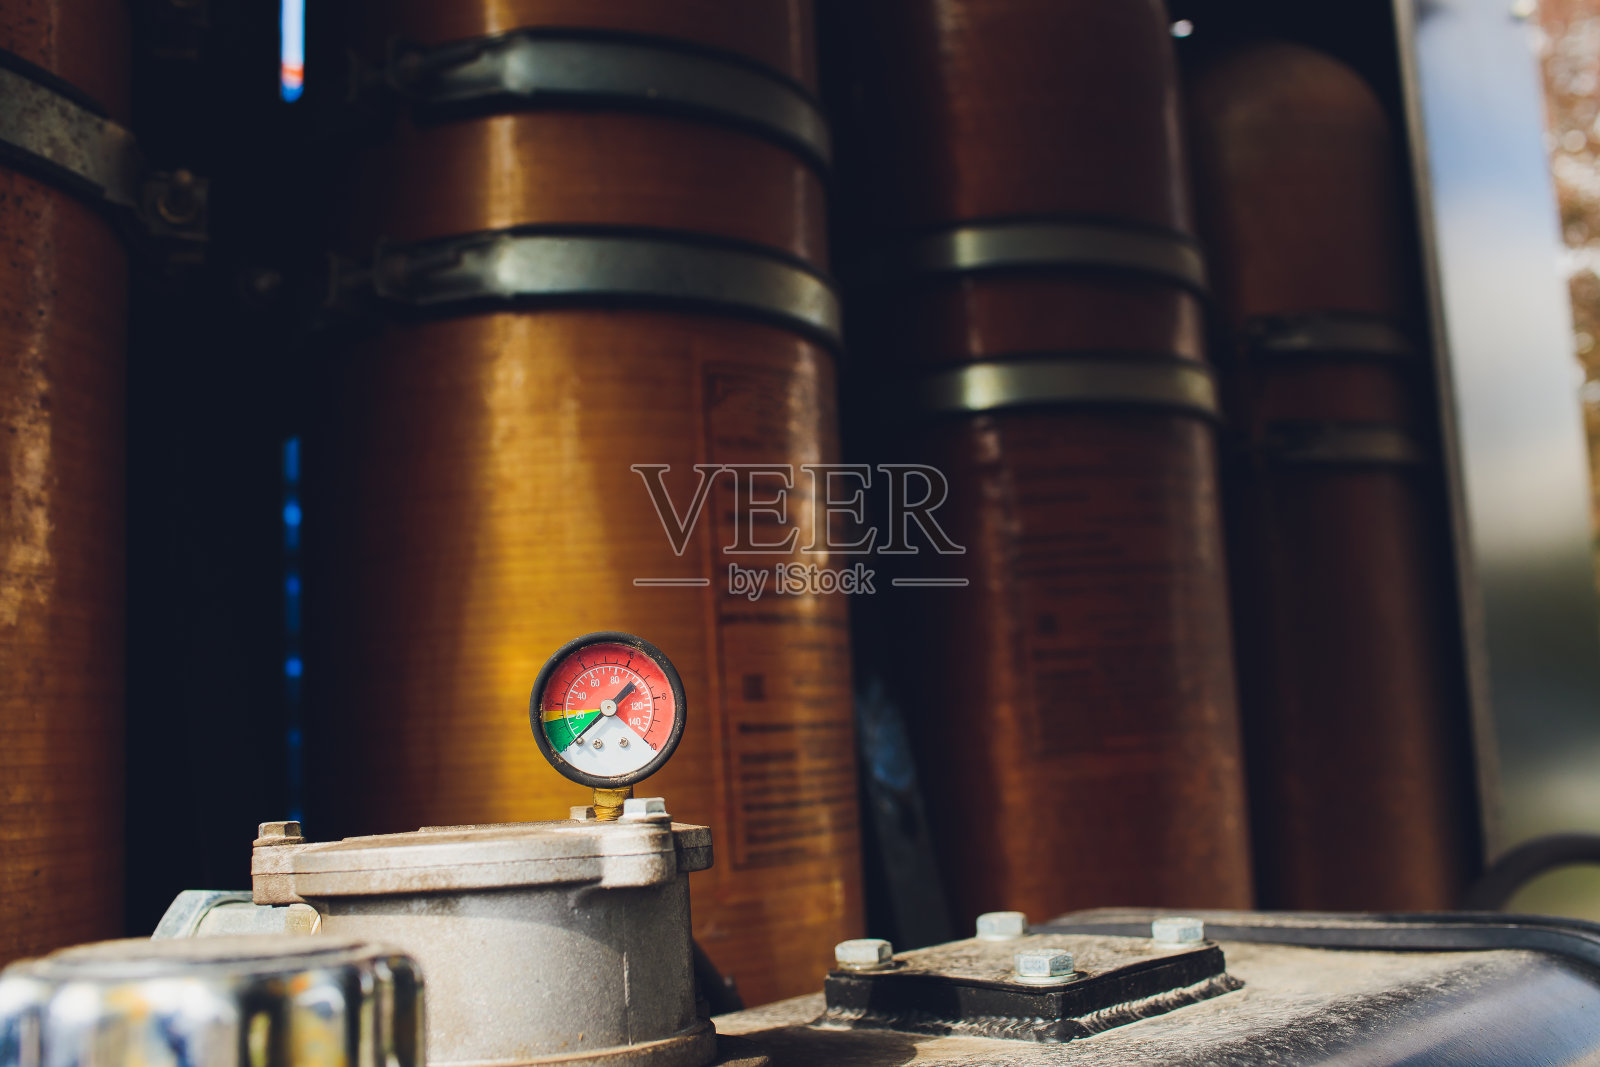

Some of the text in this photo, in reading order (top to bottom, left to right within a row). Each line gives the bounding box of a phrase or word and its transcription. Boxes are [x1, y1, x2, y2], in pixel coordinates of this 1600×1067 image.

[590, 678, 600, 688] 60
[610, 675, 620, 685] 80
[576, 691, 587, 701] 40
[630, 702, 643, 711] 120
[575, 710, 586, 720] 20
[628, 717, 641, 726] 140
